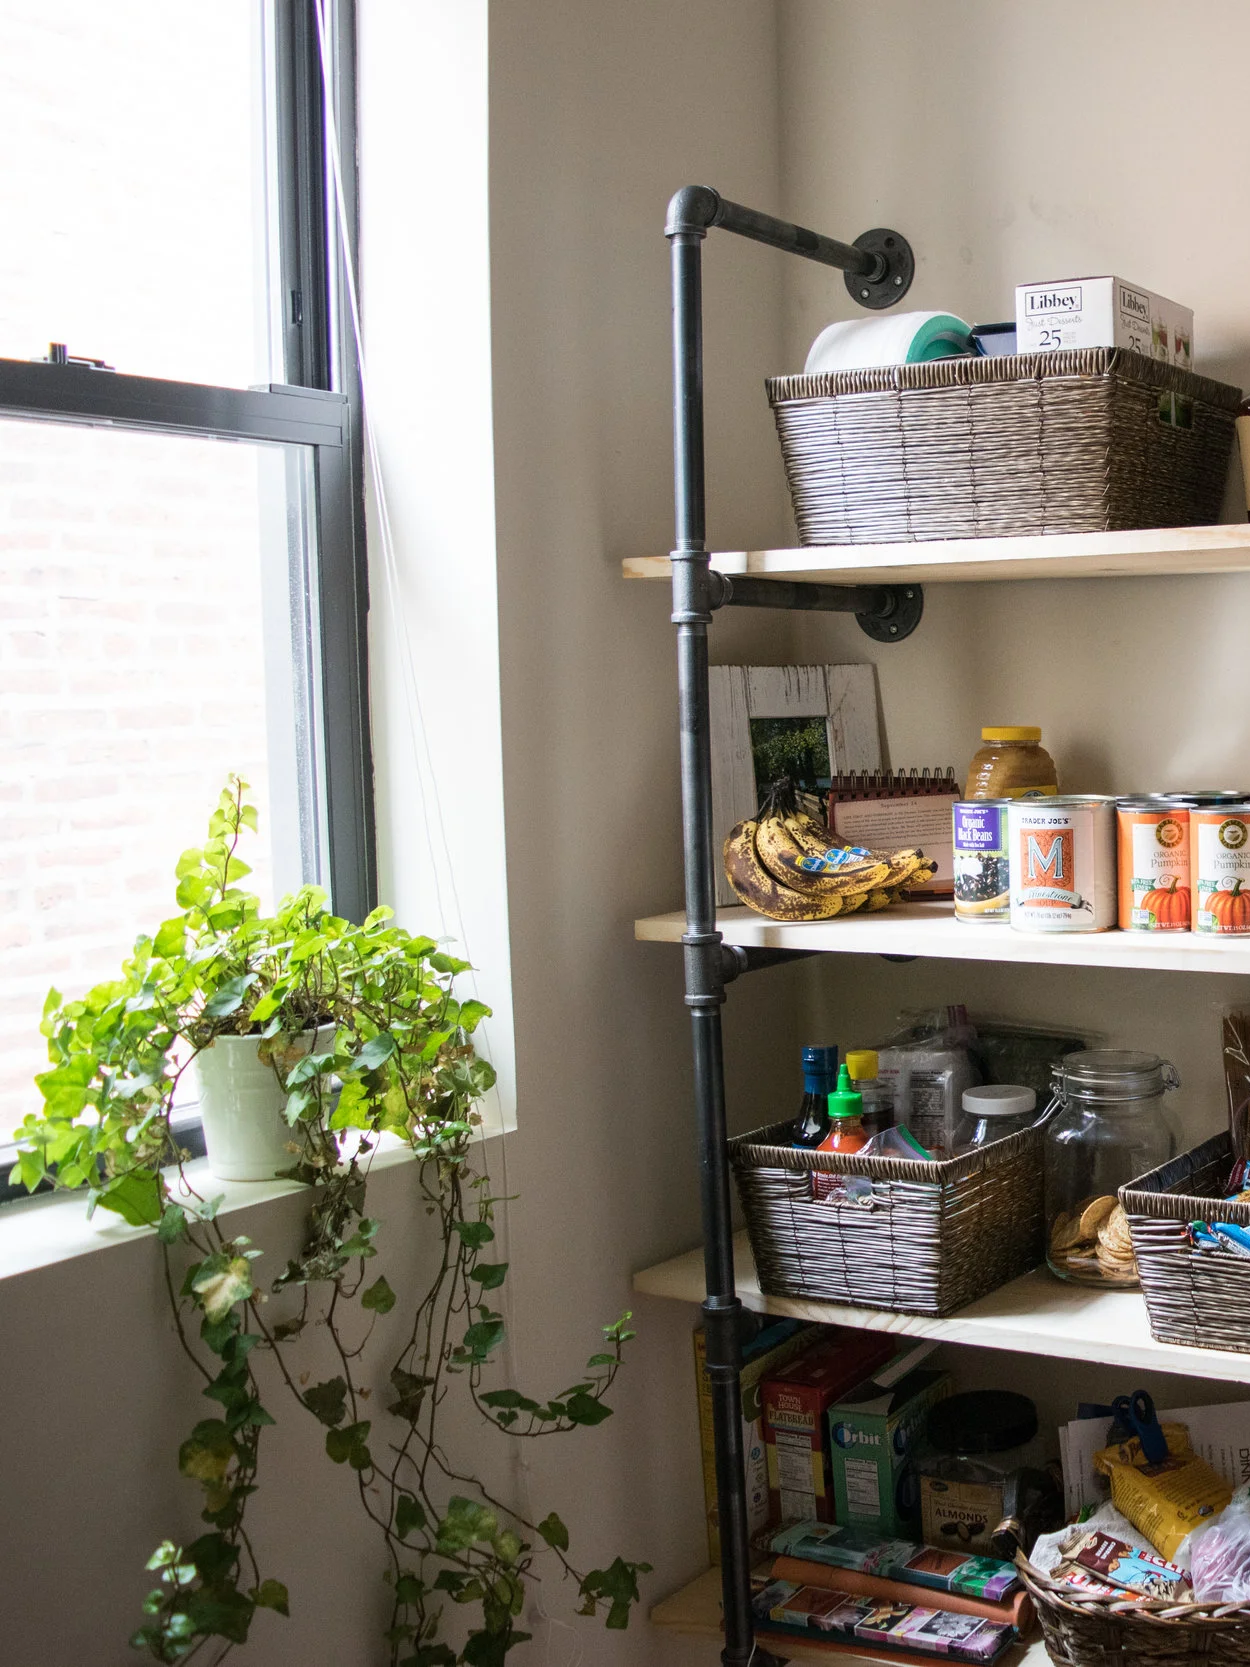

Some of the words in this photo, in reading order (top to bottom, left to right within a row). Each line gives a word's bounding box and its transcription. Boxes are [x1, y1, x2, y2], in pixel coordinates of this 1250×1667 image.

[1030, 294, 1076, 310] Libbey
[1122, 291, 1148, 319] Libbey
[1039, 329, 1062, 351] 25
[962, 815, 985, 828] Organic
[972, 829, 993, 841] Beans
[1027, 835, 1064, 879] M
[1153, 850, 1187, 858] ORGANIC
[1151, 859, 1189, 868] Pumpkin
[778, 1394, 801, 1404] TOWN
[778, 1402, 803, 1412] HOUSE
[769, 1411, 815, 1427] FLATBREAD
[837, 1425, 881, 1446] Orbit
[935, 1508, 988, 1523] ALMONDS
